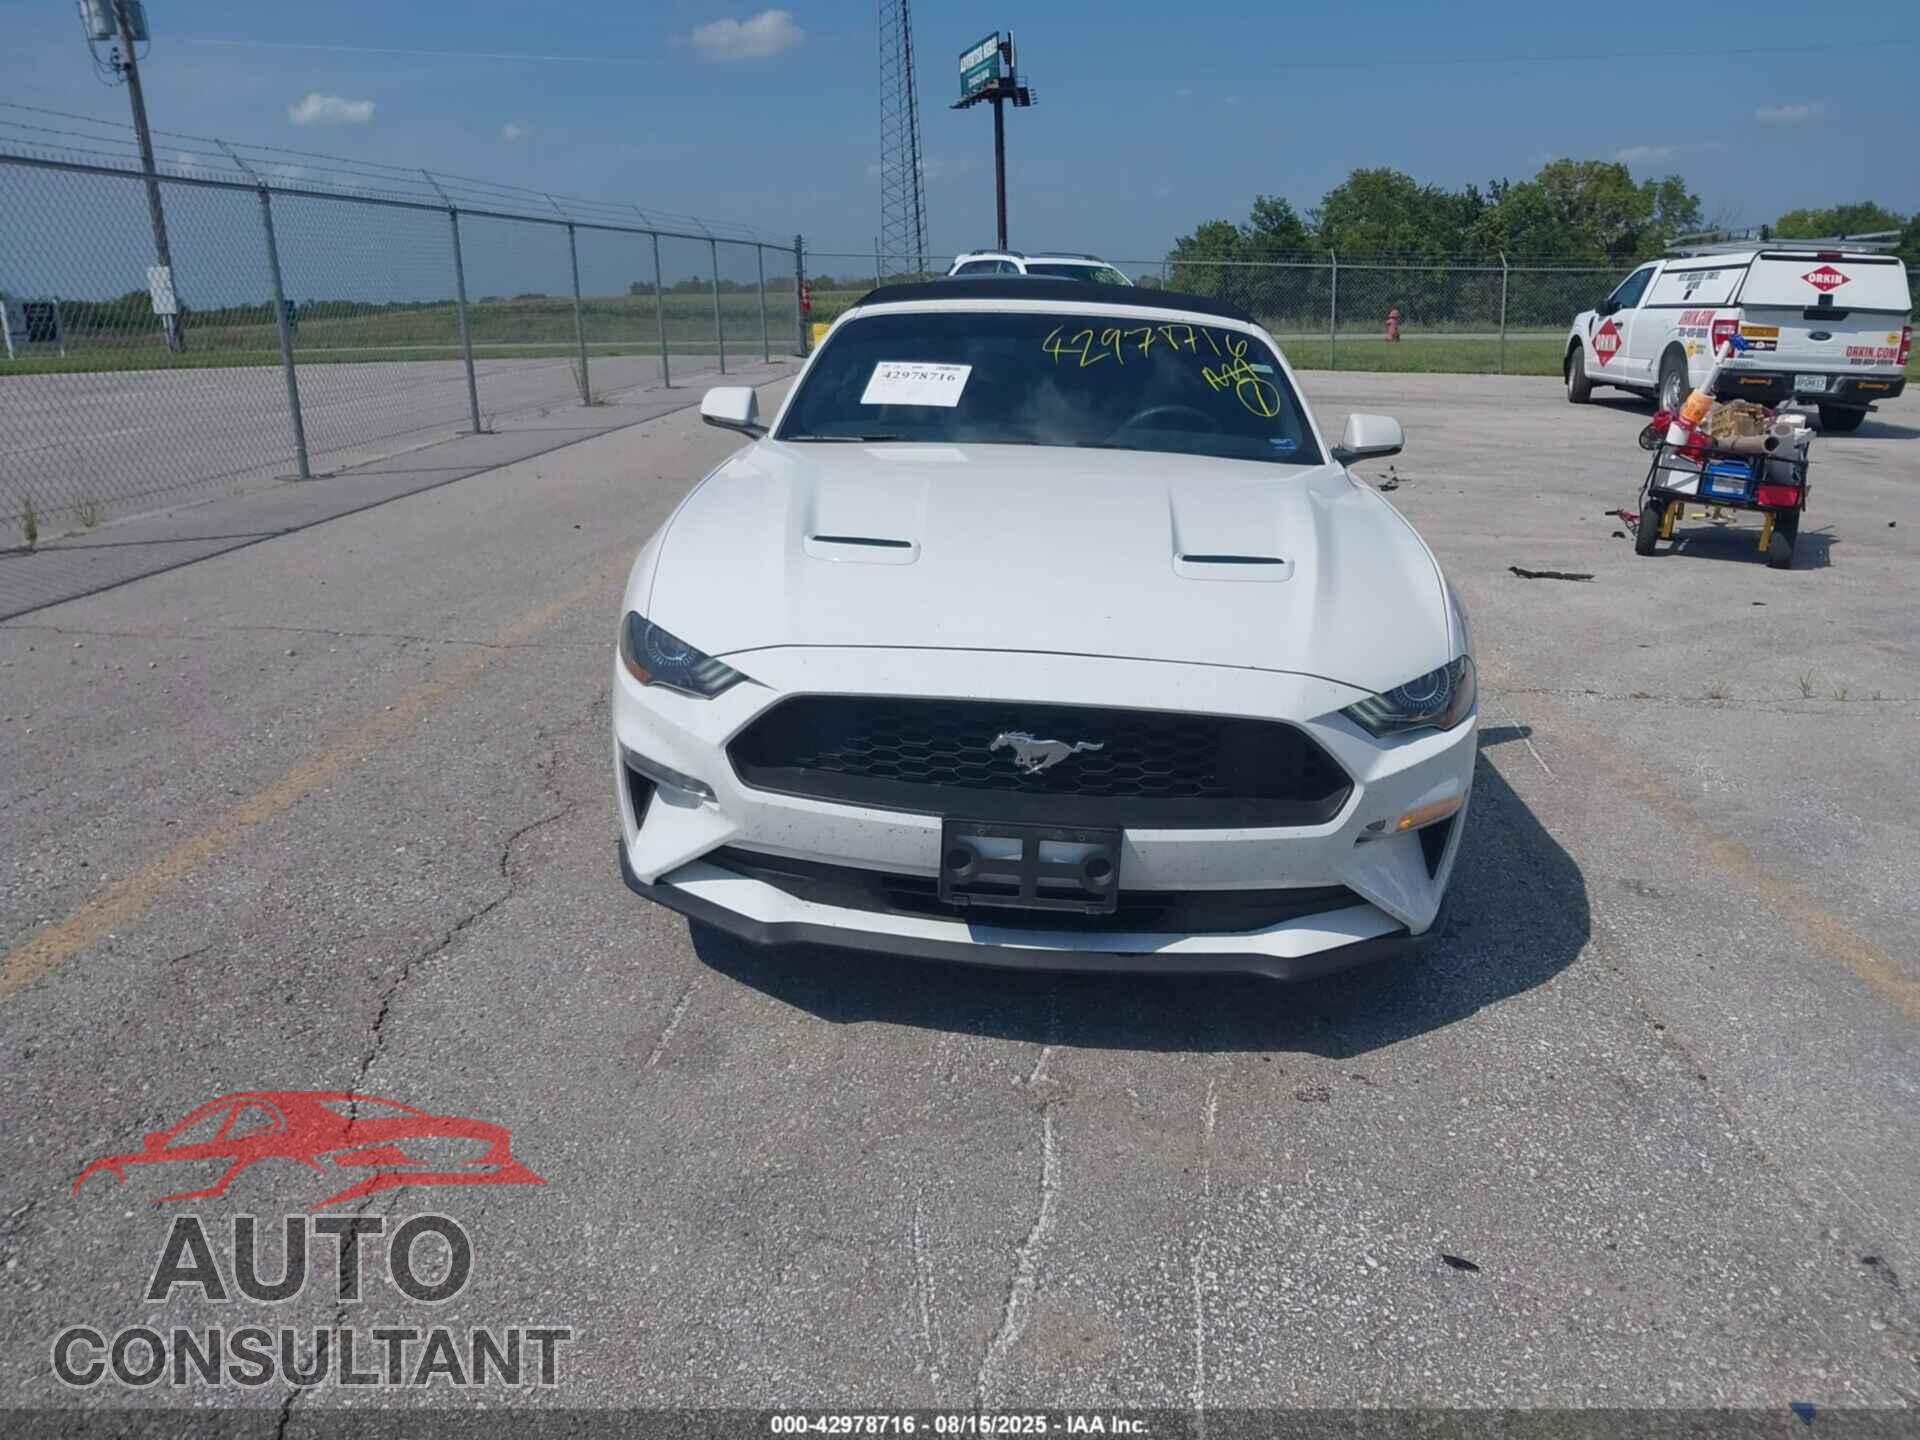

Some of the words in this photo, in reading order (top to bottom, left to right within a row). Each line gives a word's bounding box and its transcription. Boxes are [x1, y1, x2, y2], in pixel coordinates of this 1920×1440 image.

[1808, 273, 1843, 284] ORKIN
[1846, 346, 1898, 359] ORKIN.COM
[881, 370, 957, 382] 42978716
